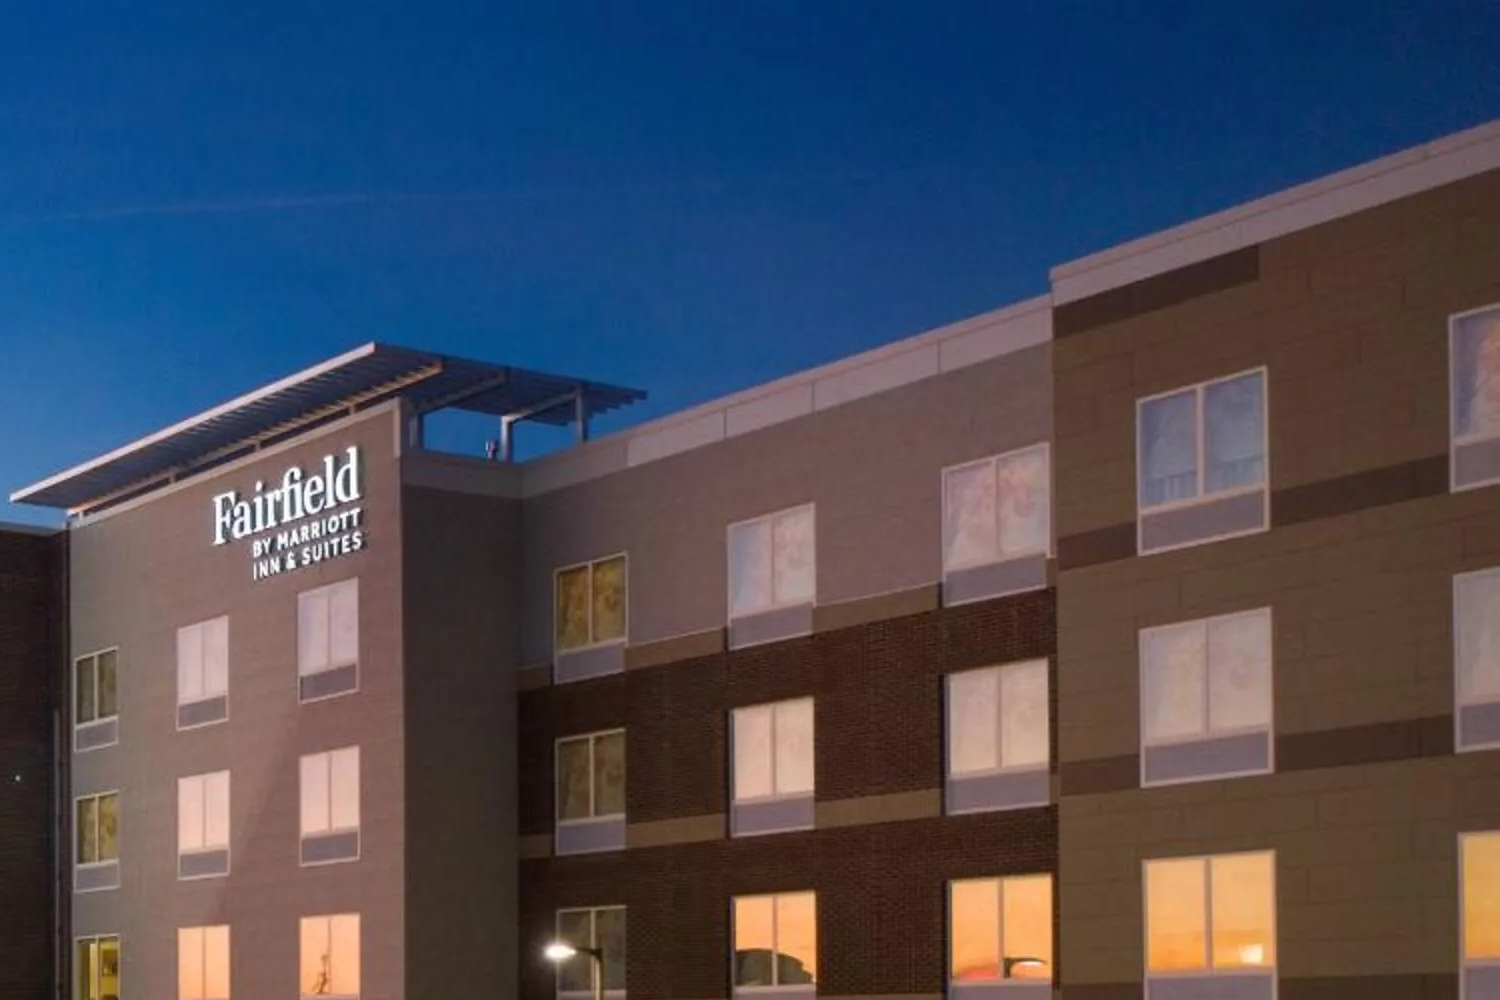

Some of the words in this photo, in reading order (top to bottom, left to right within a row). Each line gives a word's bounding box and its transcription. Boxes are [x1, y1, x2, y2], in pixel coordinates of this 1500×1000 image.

[212, 446, 360, 545] Fairfield
[253, 537, 271, 558] BY
[277, 508, 361, 550] MARRIOTT
[253, 558, 280, 580] INN
[285, 552, 297, 570] &
[302, 530, 362, 566] SUITES
